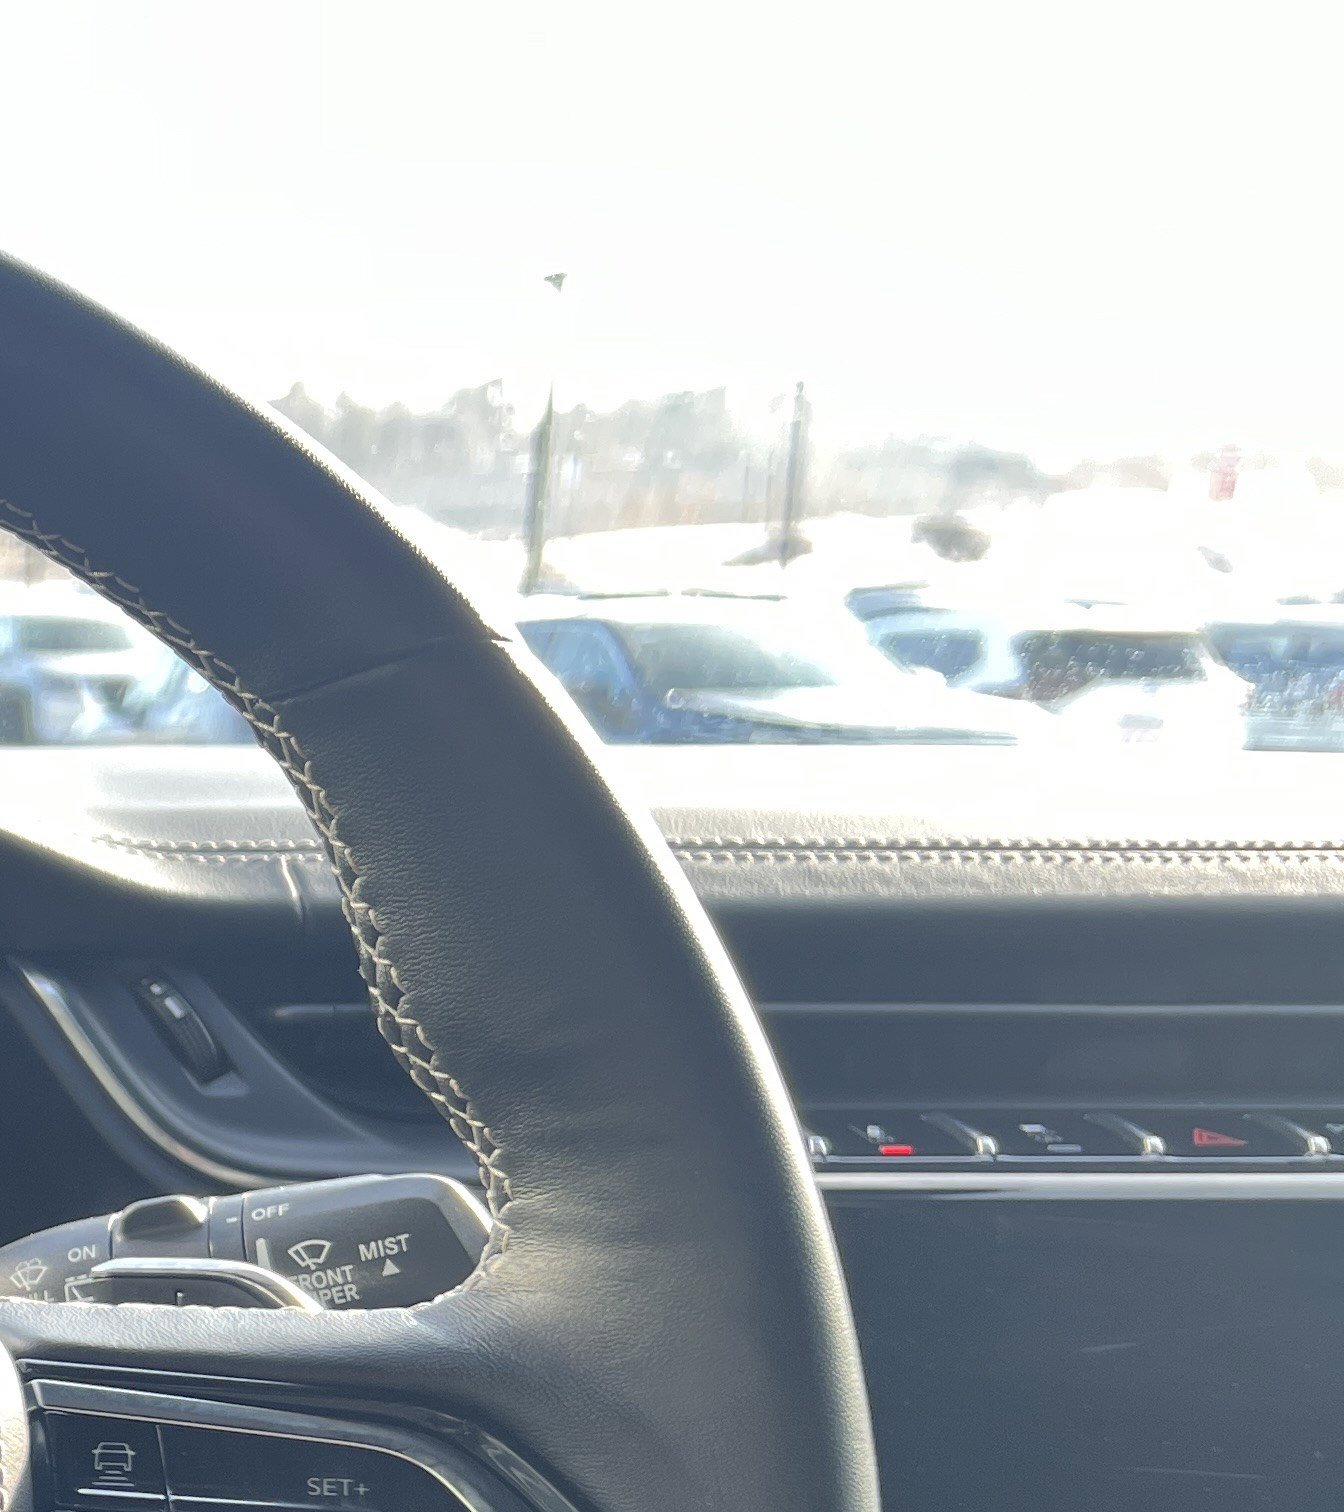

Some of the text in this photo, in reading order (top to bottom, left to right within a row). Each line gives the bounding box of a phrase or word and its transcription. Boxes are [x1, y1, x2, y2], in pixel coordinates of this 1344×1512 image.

[250, 1202, 291, 1222] OFF
[67, 1244, 96, 1264] ON
[358, 1233, 410, 1261] MIST
[306, 1478, 371, 1497] SET+
